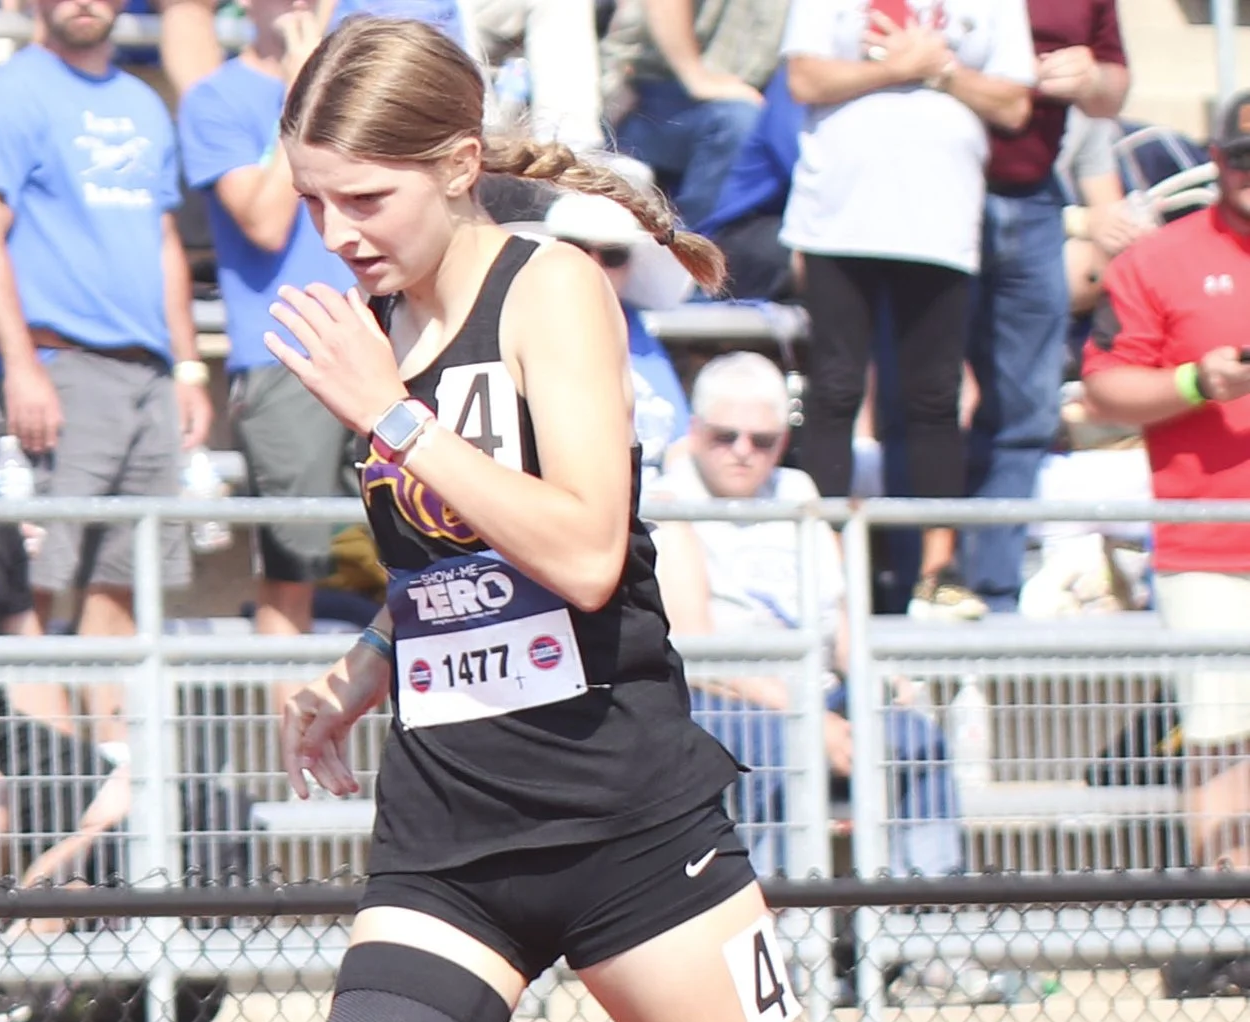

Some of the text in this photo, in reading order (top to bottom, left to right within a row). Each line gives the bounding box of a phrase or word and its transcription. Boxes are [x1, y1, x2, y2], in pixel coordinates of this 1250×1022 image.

[454, 372, 502, 458] 4
[407, 571, 514, 621] ZERO
[420, 563, 480, 586] SHOW-ME
[442, 644, 509, 687] 1477
[753, 929, 787, 1018] 4
